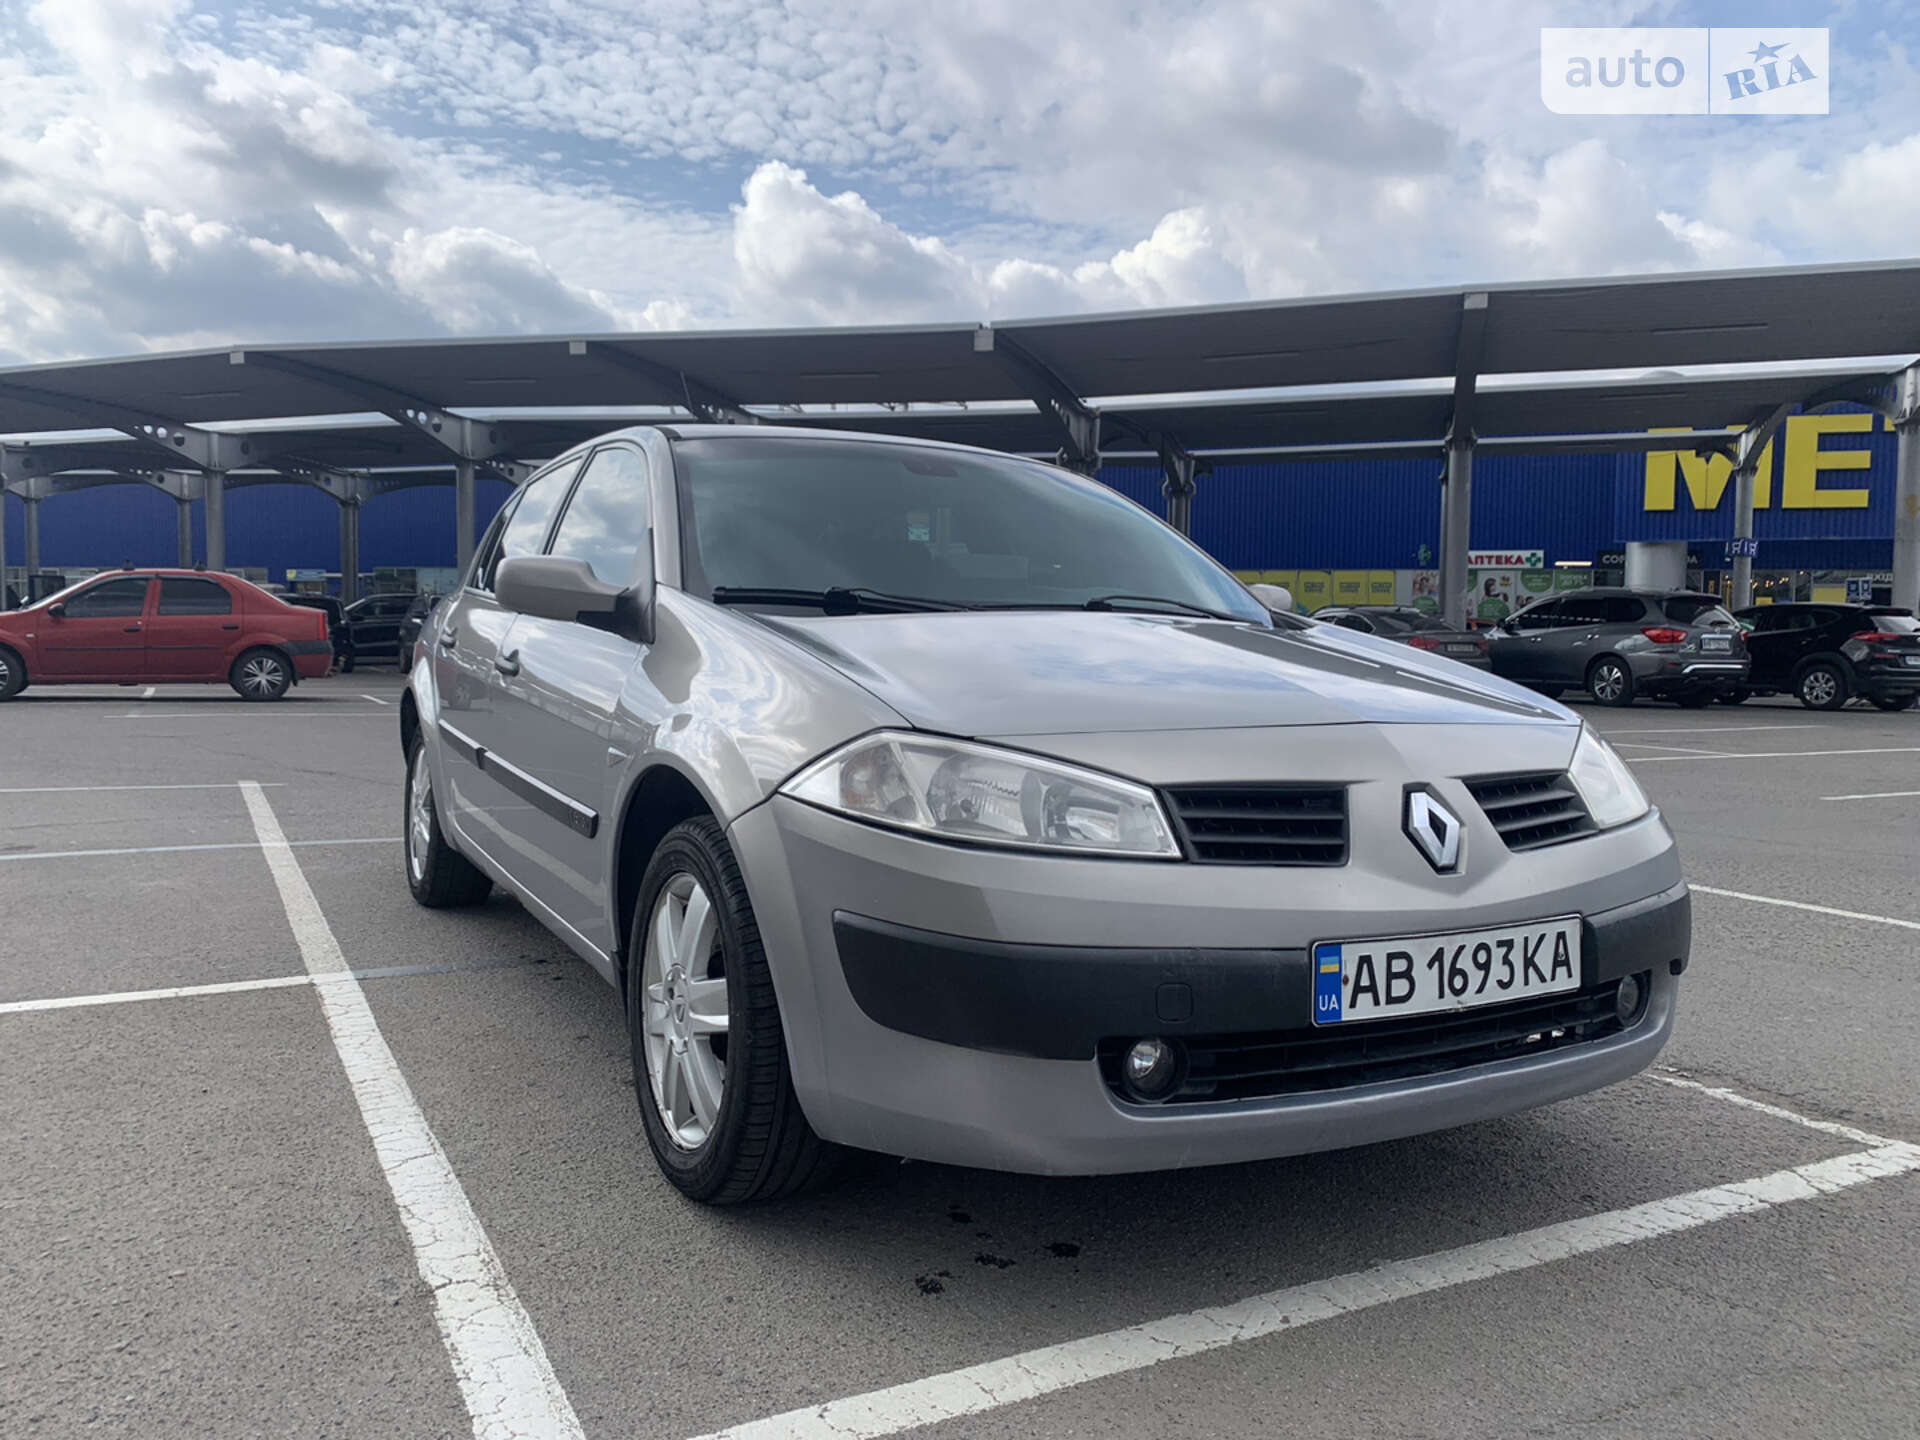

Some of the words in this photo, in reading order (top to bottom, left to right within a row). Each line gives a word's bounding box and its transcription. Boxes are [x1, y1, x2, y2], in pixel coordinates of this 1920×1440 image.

[1644, 413, 1896, 510] ME
[1319, 995, 1339, 1011] UA
[1349, 951, 1416, 1009] AB
[1427, 938, 1515, 999] 1693
